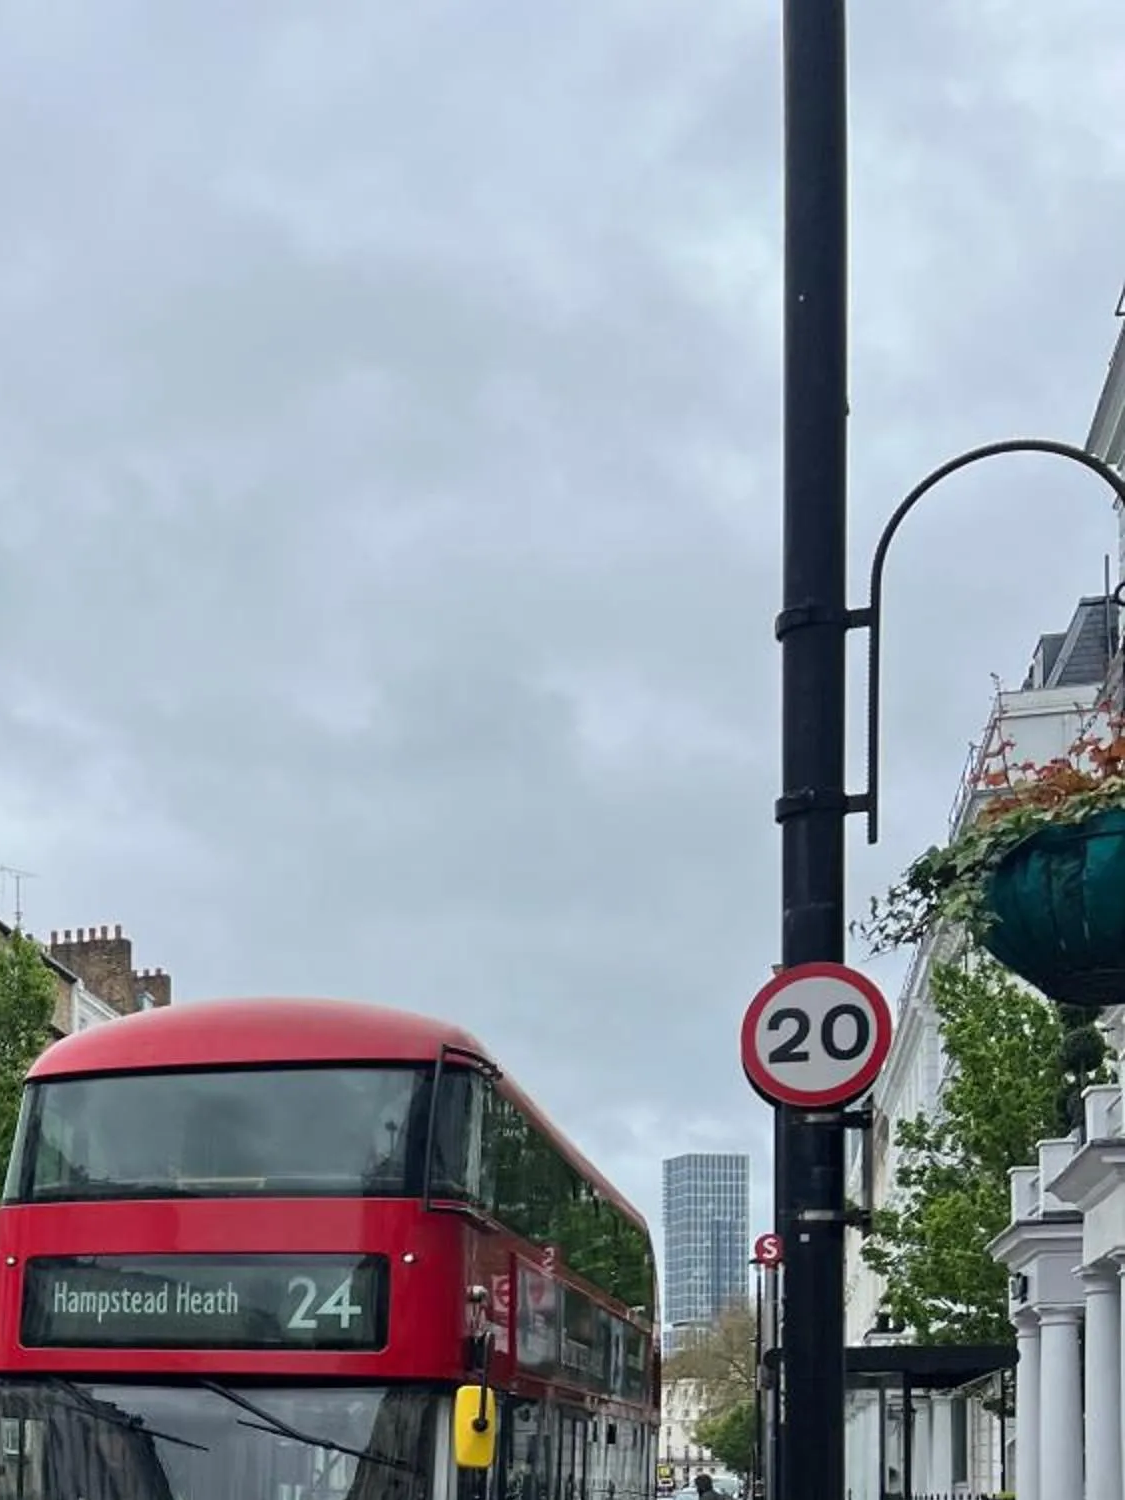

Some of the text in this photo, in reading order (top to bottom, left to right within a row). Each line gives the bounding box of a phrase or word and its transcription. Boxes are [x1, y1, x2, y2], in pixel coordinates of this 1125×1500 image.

[767, 1003, 870, 1064] 20
[763, 1237, 777, 1259] S
[54, 1281, 238, 1323] Hampstead Heath
[287, 1272, 362, 1329] 24
